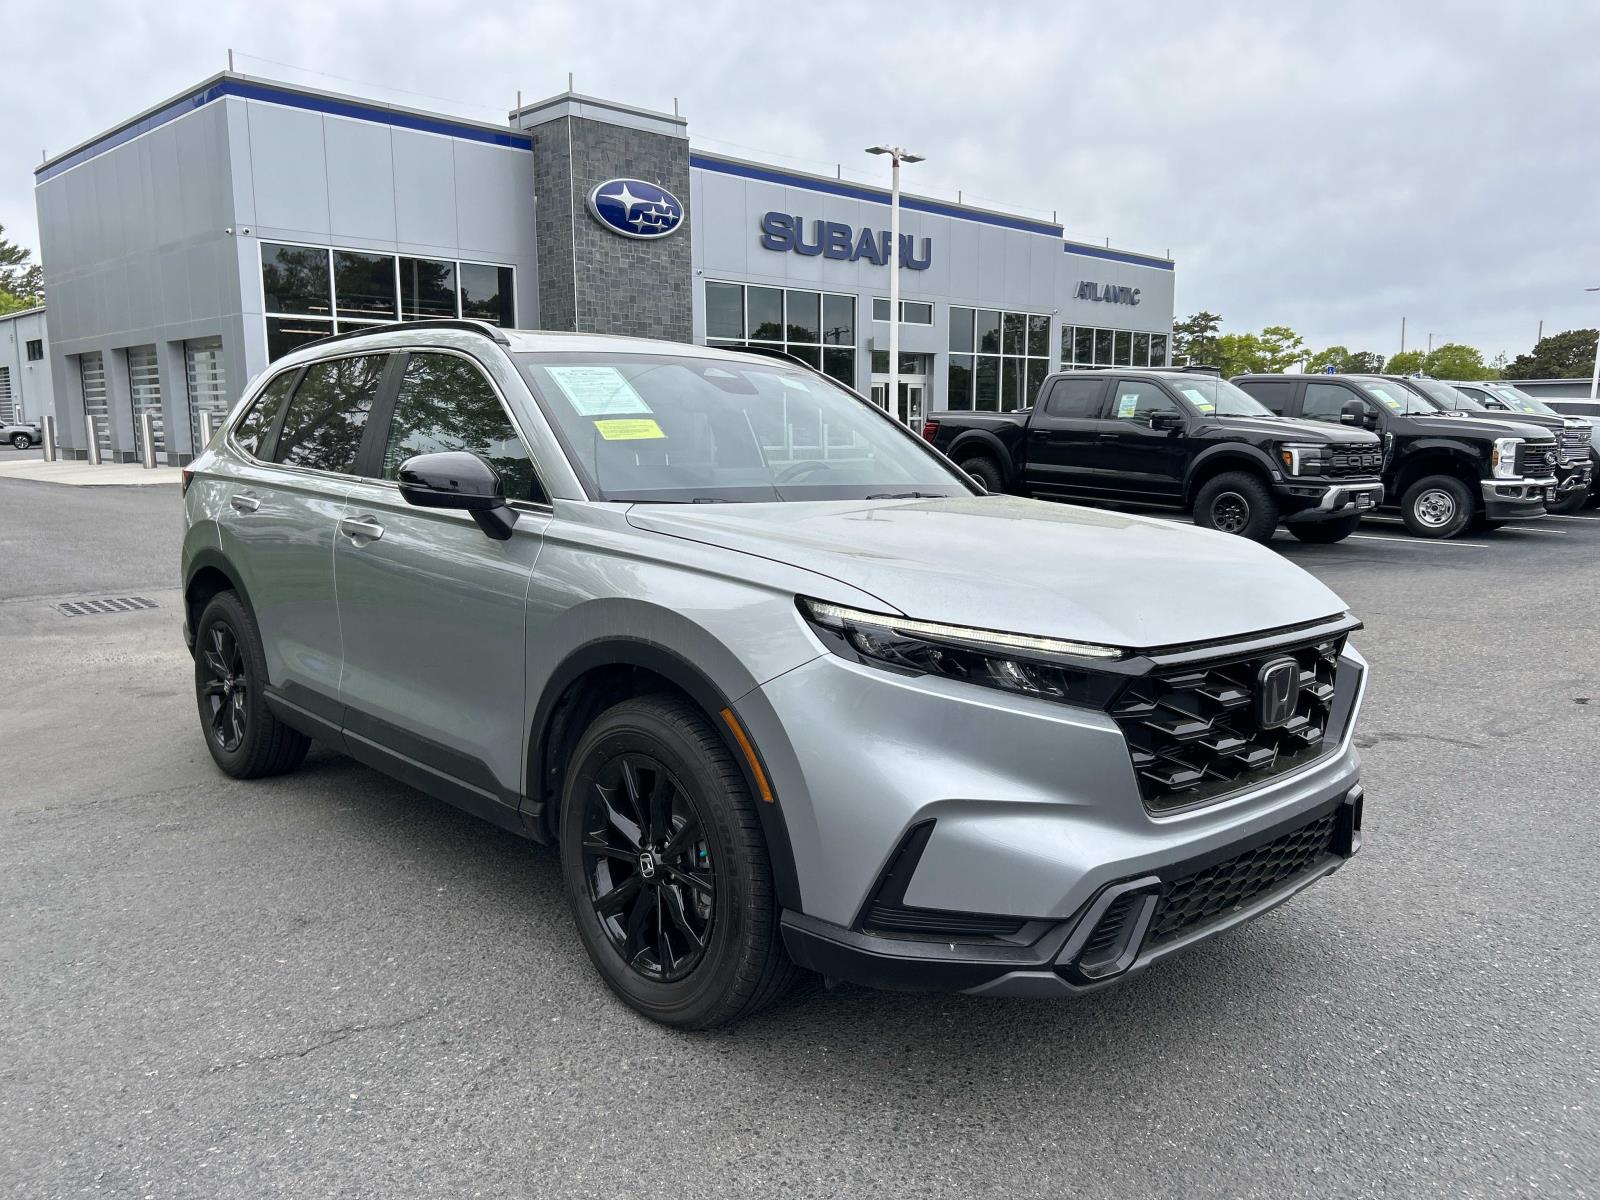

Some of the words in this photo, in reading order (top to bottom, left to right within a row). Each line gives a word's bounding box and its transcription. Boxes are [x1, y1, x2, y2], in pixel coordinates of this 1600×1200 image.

[761, 211, 932, 270] SUBARU
[1073, 280, 1141, 306] ATLANTIC
[1331, 455, 1382, 468] FORD
